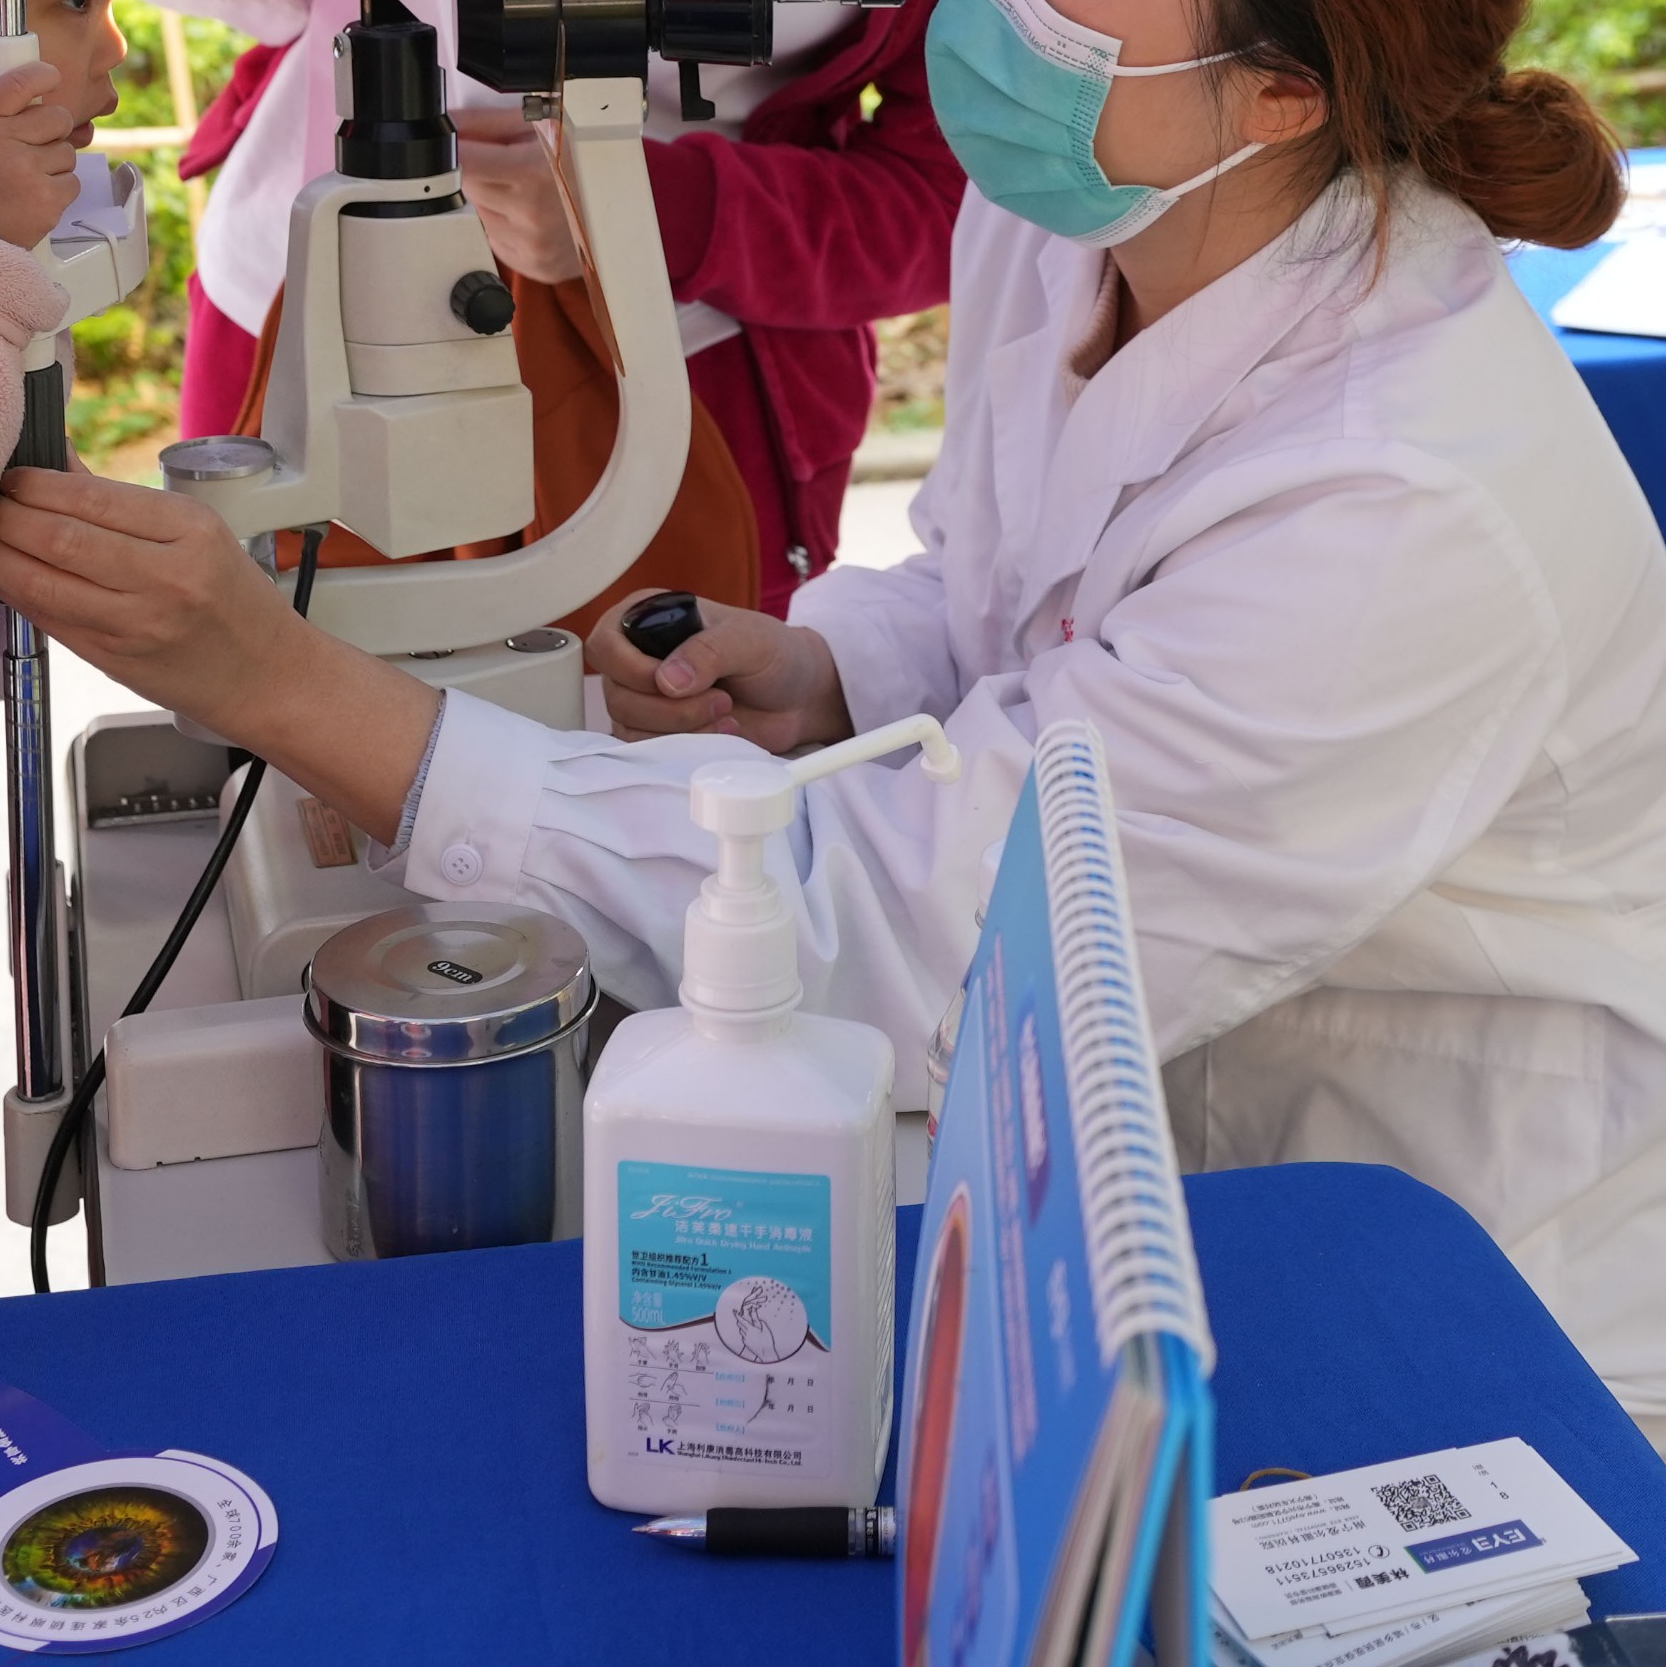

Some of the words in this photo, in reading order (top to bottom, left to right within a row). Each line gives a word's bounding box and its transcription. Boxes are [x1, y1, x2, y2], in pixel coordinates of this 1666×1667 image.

[432, 962, 473, 982] 9cm
[646, 1437, 675, 1455] LK
[677, 1441, 802, 1461] 上海利康消毒高科技有限公司
[1260, 1520, 1366, 1550] 南宁爱尔眼科医院
[1265, 1546, 1361, 1575] 13507710218
[1423, 1546, 1472, 1564] 爱尔眼科
[1277, 1558, 1371, 1586] 15296573511
[1355, 1567, 1410, 1590] 林美霞
